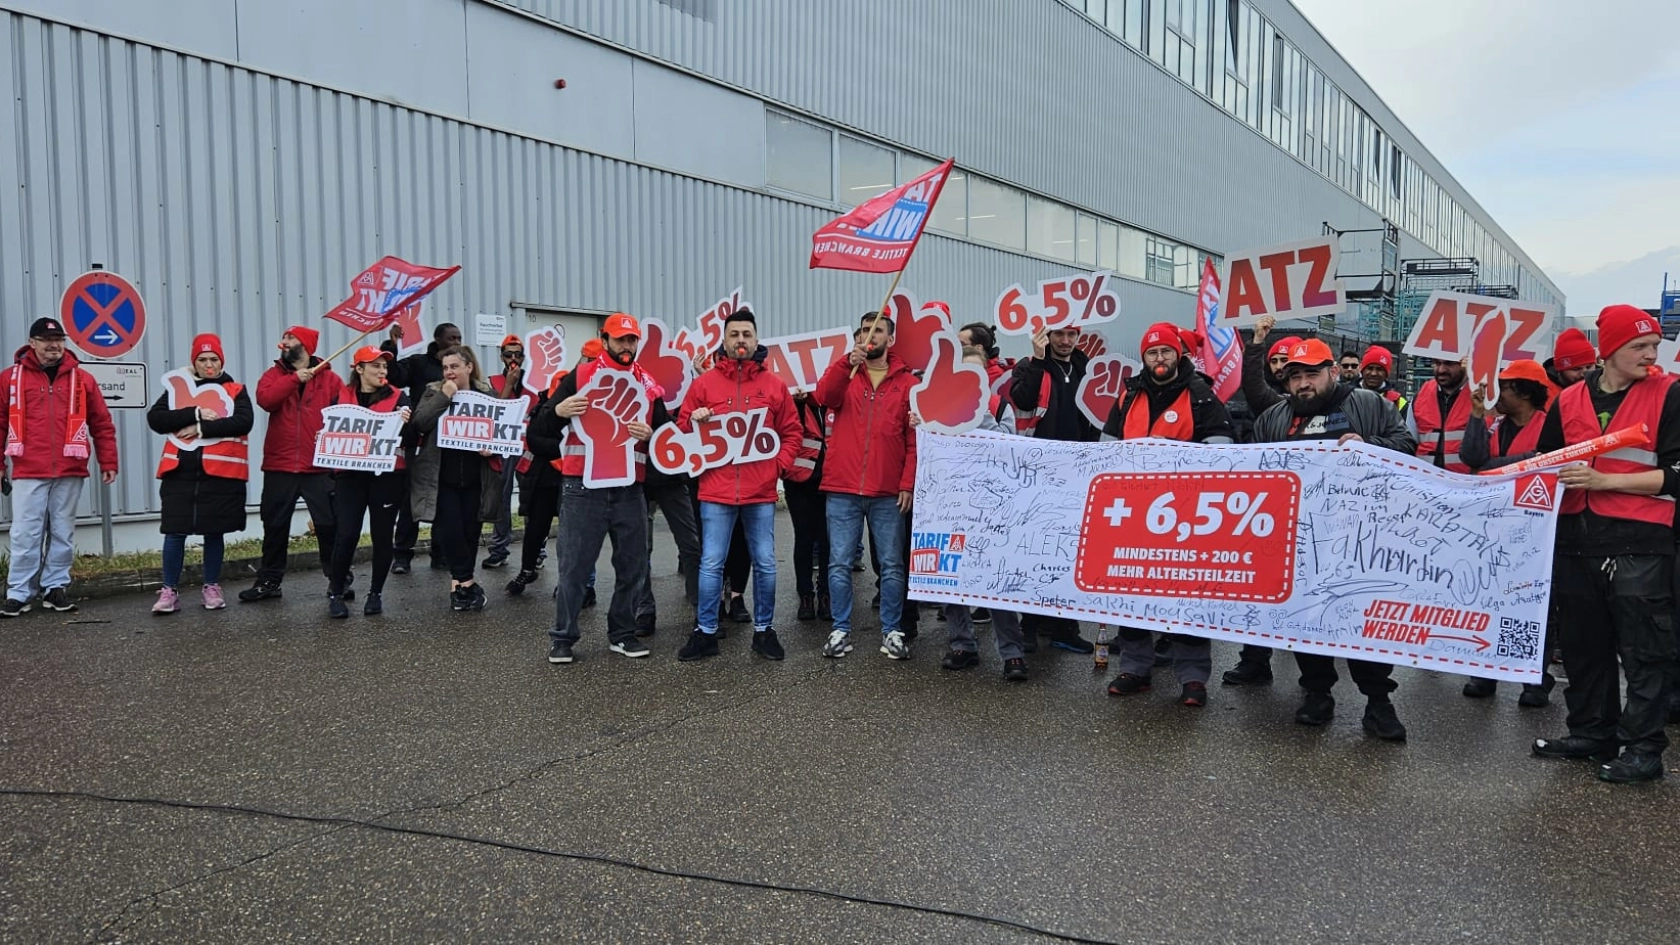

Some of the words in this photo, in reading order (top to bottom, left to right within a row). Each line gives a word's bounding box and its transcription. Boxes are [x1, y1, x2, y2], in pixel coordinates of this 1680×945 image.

[1225, 244, 1338, 319] ATZ
[998, 275, 1117, 335] 6,5%
[97, 381, 126, 391] rsand
[450, 401, 506, 421] TARIF
[327, 415, 385, 437] TARIF
[446, 419, 522, 441] WIRKT
[323, 436, 398, 457] WIRKT
[440, 438, 475, 449] TEXTILE
[476, 443, 520, 454] BRANCHEN
[654, 413, 775, 474] 6,5%
[317, 457, 349, 467] TEXTILE
[351, 460, 392, 470] BRANCHEN
[1146, 491, 1275, 542] 6,5%
[913, 532, 950, 550] TARIF
[1113, 546, 1197, 562] MINDESTENS
[1212, 550, 1238, 563] 200
[1243, 551, 1253, 564] €
[1107, 565, 1144, 579] MEHR
[1147, 566, 1256, 584] ALTERSTEILZEIT
[1364, 599, 1411, 621] JETZT
[1409, 604, 1490, 632] MITGLIED
[1362, 619, 1431, 646] WERDEN
